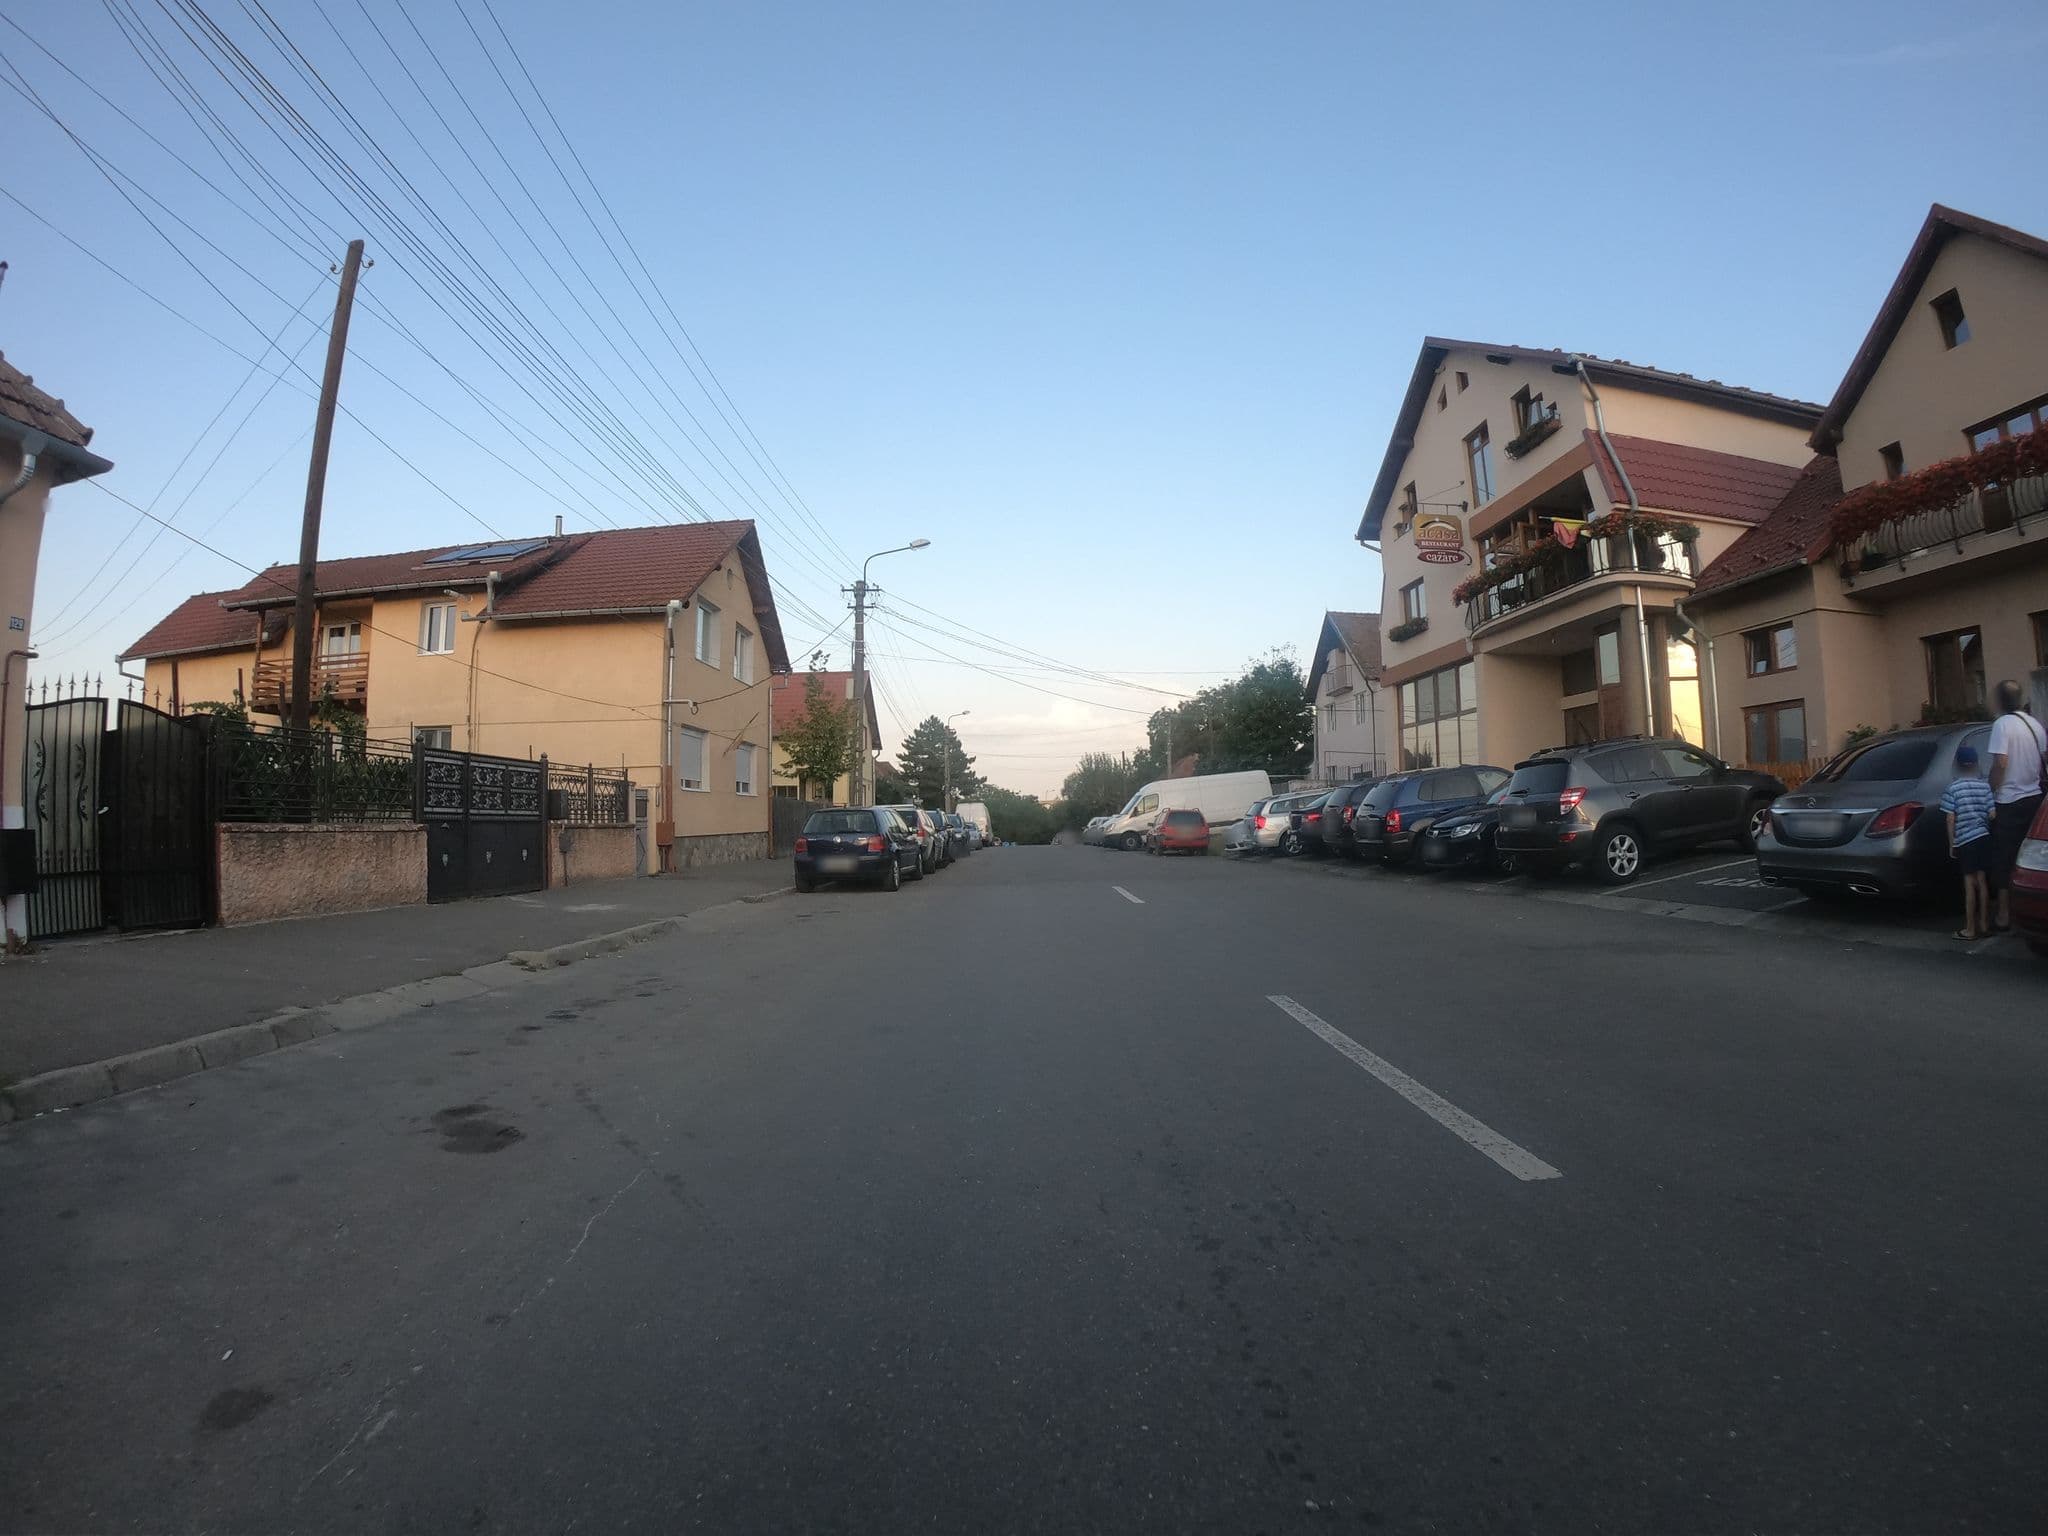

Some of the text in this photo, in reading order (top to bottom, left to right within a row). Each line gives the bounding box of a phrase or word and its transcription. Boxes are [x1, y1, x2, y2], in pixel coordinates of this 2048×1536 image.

[1418, 528, 1460, 540] acasa
[1421, 540, 1460, 548] RESTAURANT
[1426, 553, 1459, 562] cazare
